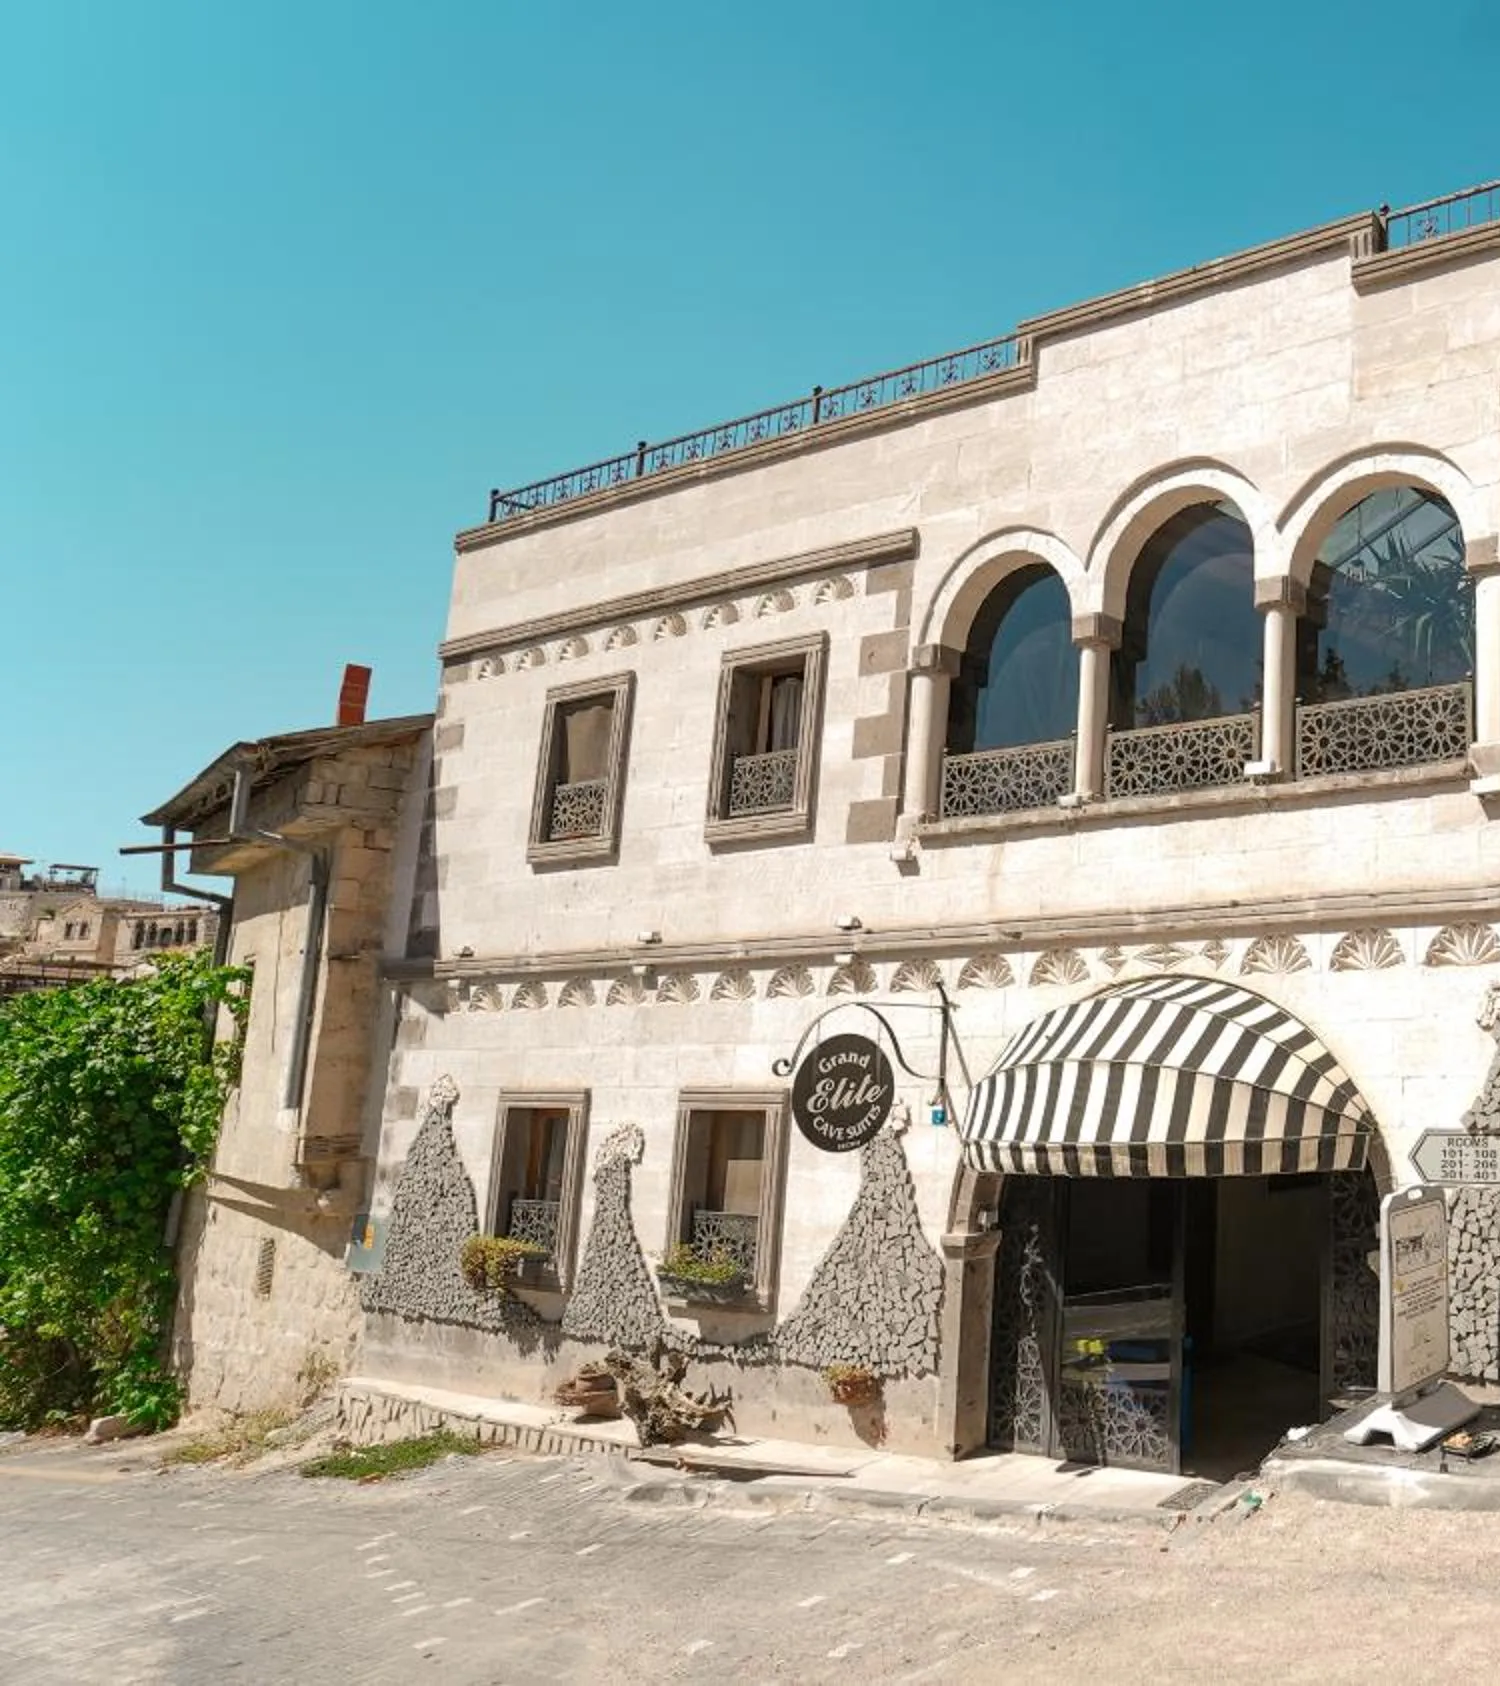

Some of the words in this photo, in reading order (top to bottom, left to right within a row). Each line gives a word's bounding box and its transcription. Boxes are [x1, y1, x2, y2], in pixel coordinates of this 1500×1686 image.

[818, 1052, 870, 1073] Grand
[806, 1073, 888, 1113] Elite
[813, 1115, 844, 1141] CAVE
[1447, 1137, 1489, 1148] ROOMS
